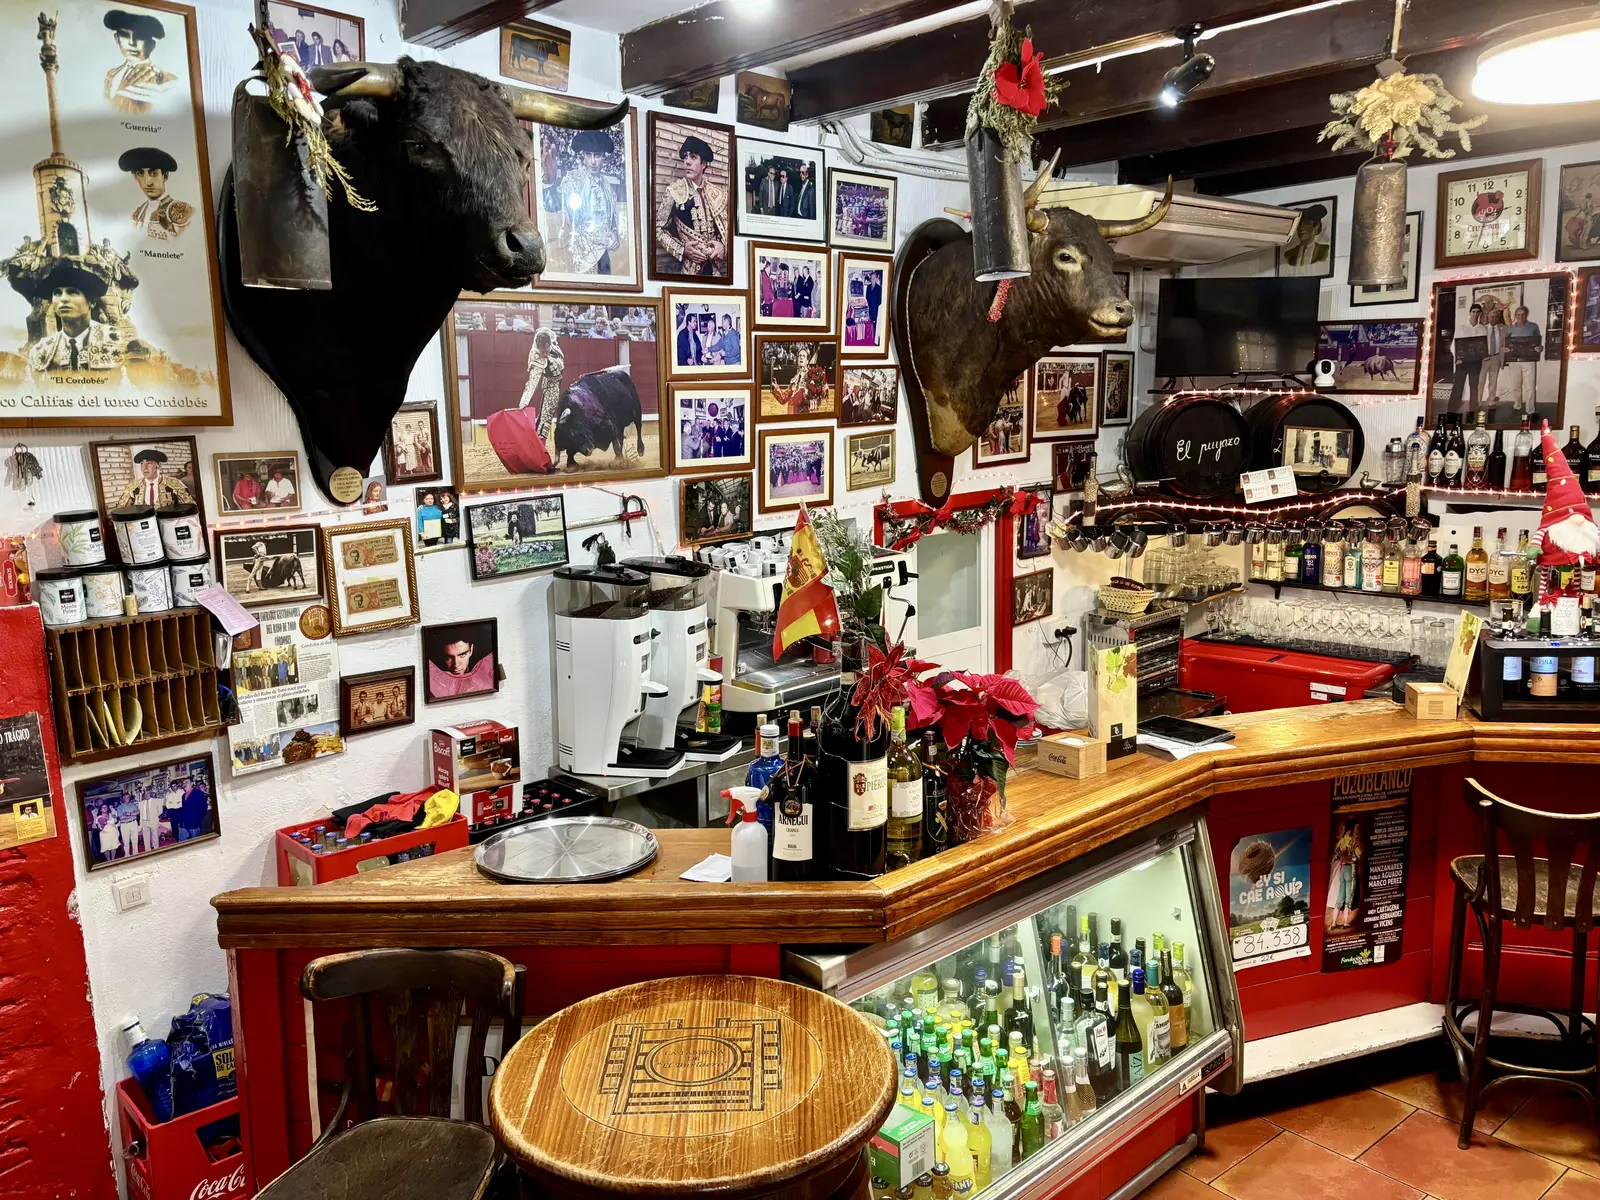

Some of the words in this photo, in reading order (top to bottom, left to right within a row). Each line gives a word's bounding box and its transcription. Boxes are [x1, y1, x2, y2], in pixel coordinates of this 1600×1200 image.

[1467, 183, 1477, 193] 11
[1482, 181, 1494, 191] 12
[1504, 179, 1508, 188] 1
[1515, 189, 1523, 198] 2
[1453, 196, 1465, 206] 10
[1515, 206, 1522, 215] 3
[1455, 214, 1462, 223] 9
[1512, 223, 1521, 232] 4
[1454, 230, 1461, 239] 8
[1467, 240, 1474, 250] 7
[1500, 236, 1507, 246] 5
[21, 395, 74, 408] Califas
[80, 395, 101, 408] del
[104, 397, 139, 408] toreo
[144, 395, 208, 408] Cordobés
[1176, 438, 1191, 461] El
[1198, 436, 1240, 464] puyazo
[3, 727, 30, 744] TRÁGICO
[434, 742, 451, 757] Biscoff
[1048, 752, 1067, 765] Coca-Cola
[1333, 768, 1412, 796] POZOBLANCO
[778, 814, 809, 826] ARNEGUI
[1369, 863, 1403, 873] MANZANARES
[1256, 873, 1271, 888] ¿Y
[1273, 871, 1285, 885] SI
[1381, 870, 1402, 879] AGUADO
[1368, 880, 1387, 888] MARCO
[1239, 888, 1263, 905] CAE
[1266, 877, 1303, 899] AQUÍ?
[1376, 903, 1400, 913] CARTAGENA
[1243, 926, 1300, 954] 84.338
[1260, 954, 1275, 962] 22€
